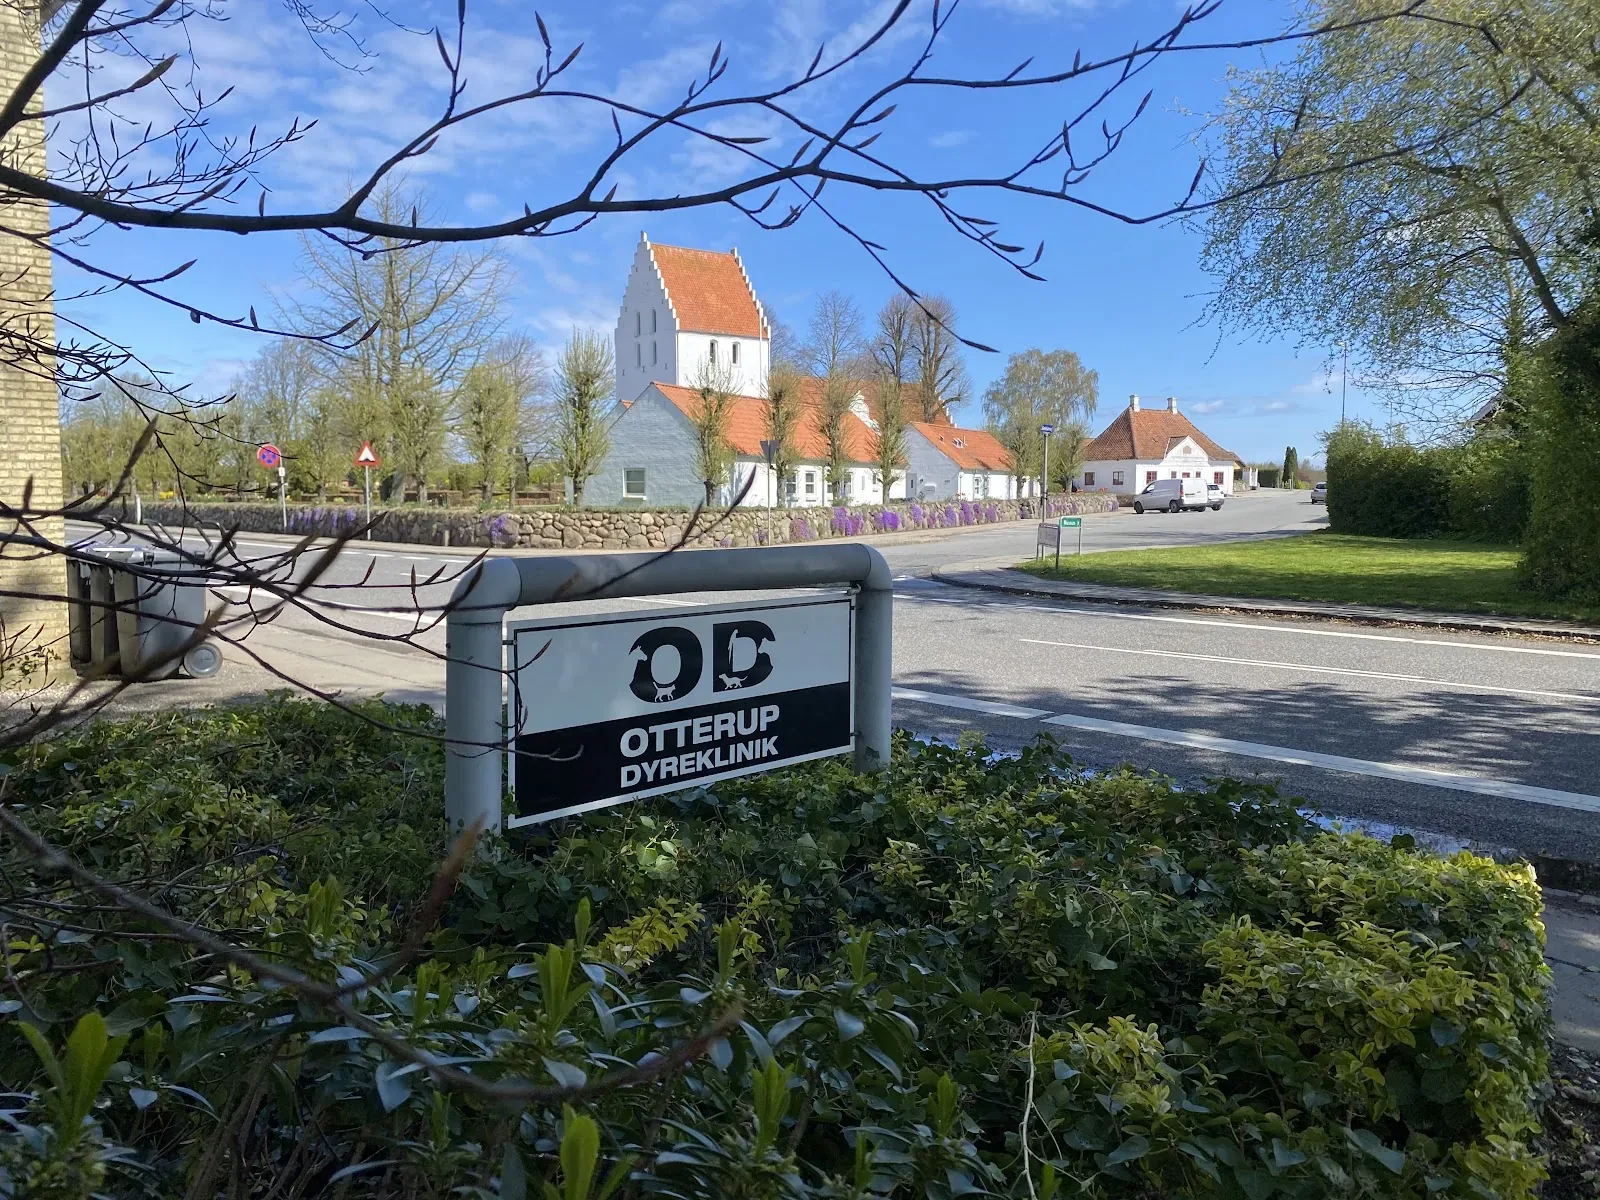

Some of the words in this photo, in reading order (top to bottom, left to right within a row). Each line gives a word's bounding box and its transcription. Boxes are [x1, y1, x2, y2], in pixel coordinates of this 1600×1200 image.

[628, 620, 776, 703] OD
[620, 704, 780, 758] OTTERUP
[620, 735, 779, 789] DYREKLINIK
